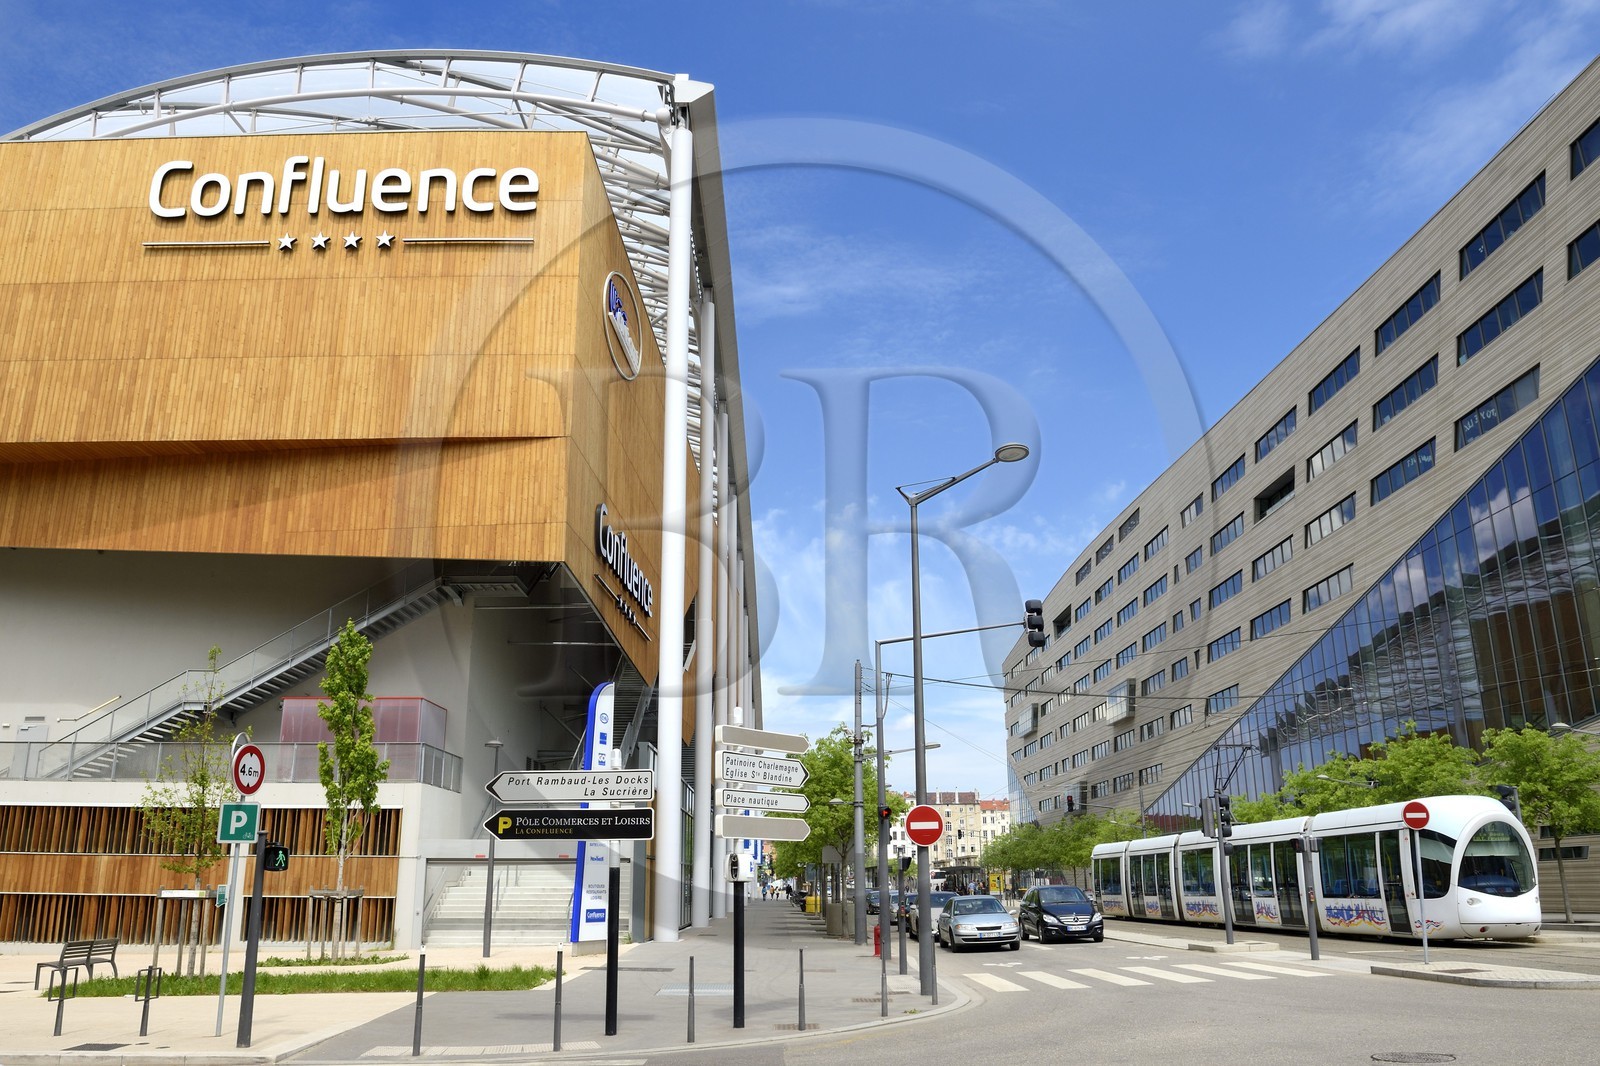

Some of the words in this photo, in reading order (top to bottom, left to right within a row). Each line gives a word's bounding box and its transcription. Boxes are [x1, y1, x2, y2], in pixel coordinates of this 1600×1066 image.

[149, 156, 540, 219] Confluence
[597, 502, 653, 618] Confluence
[725, 756, 756, 768] Patinoire
[758, 760, 799, 774] Charlemagne
[507, 776, 531, 786] Port
[536, 775, 610, 786] Rambaud-Les
[615, 775, 650, 785] Docks
[725, 768, 748, 779] Eglise
[762, 771, 793, 783] Blandine
[583, 787, 596, 796] La
[601, 786, 649, 796] Sucrière
[725, 793, 746, 804] Place
[748, 797, 779, 808] nautique
[228, 810, 248, 835] P
[498, 816, 513, 834] P
[515, 815, 540, 826] PÔLE
[541, 816, 600, 826] COMMERCES
[601, 817, 614, 826] ET
[614, 816, 651, 826] LOISIRS
[515, 827, 525, 835] LA
[525, 827, 574, 835] CONFLUENCE
